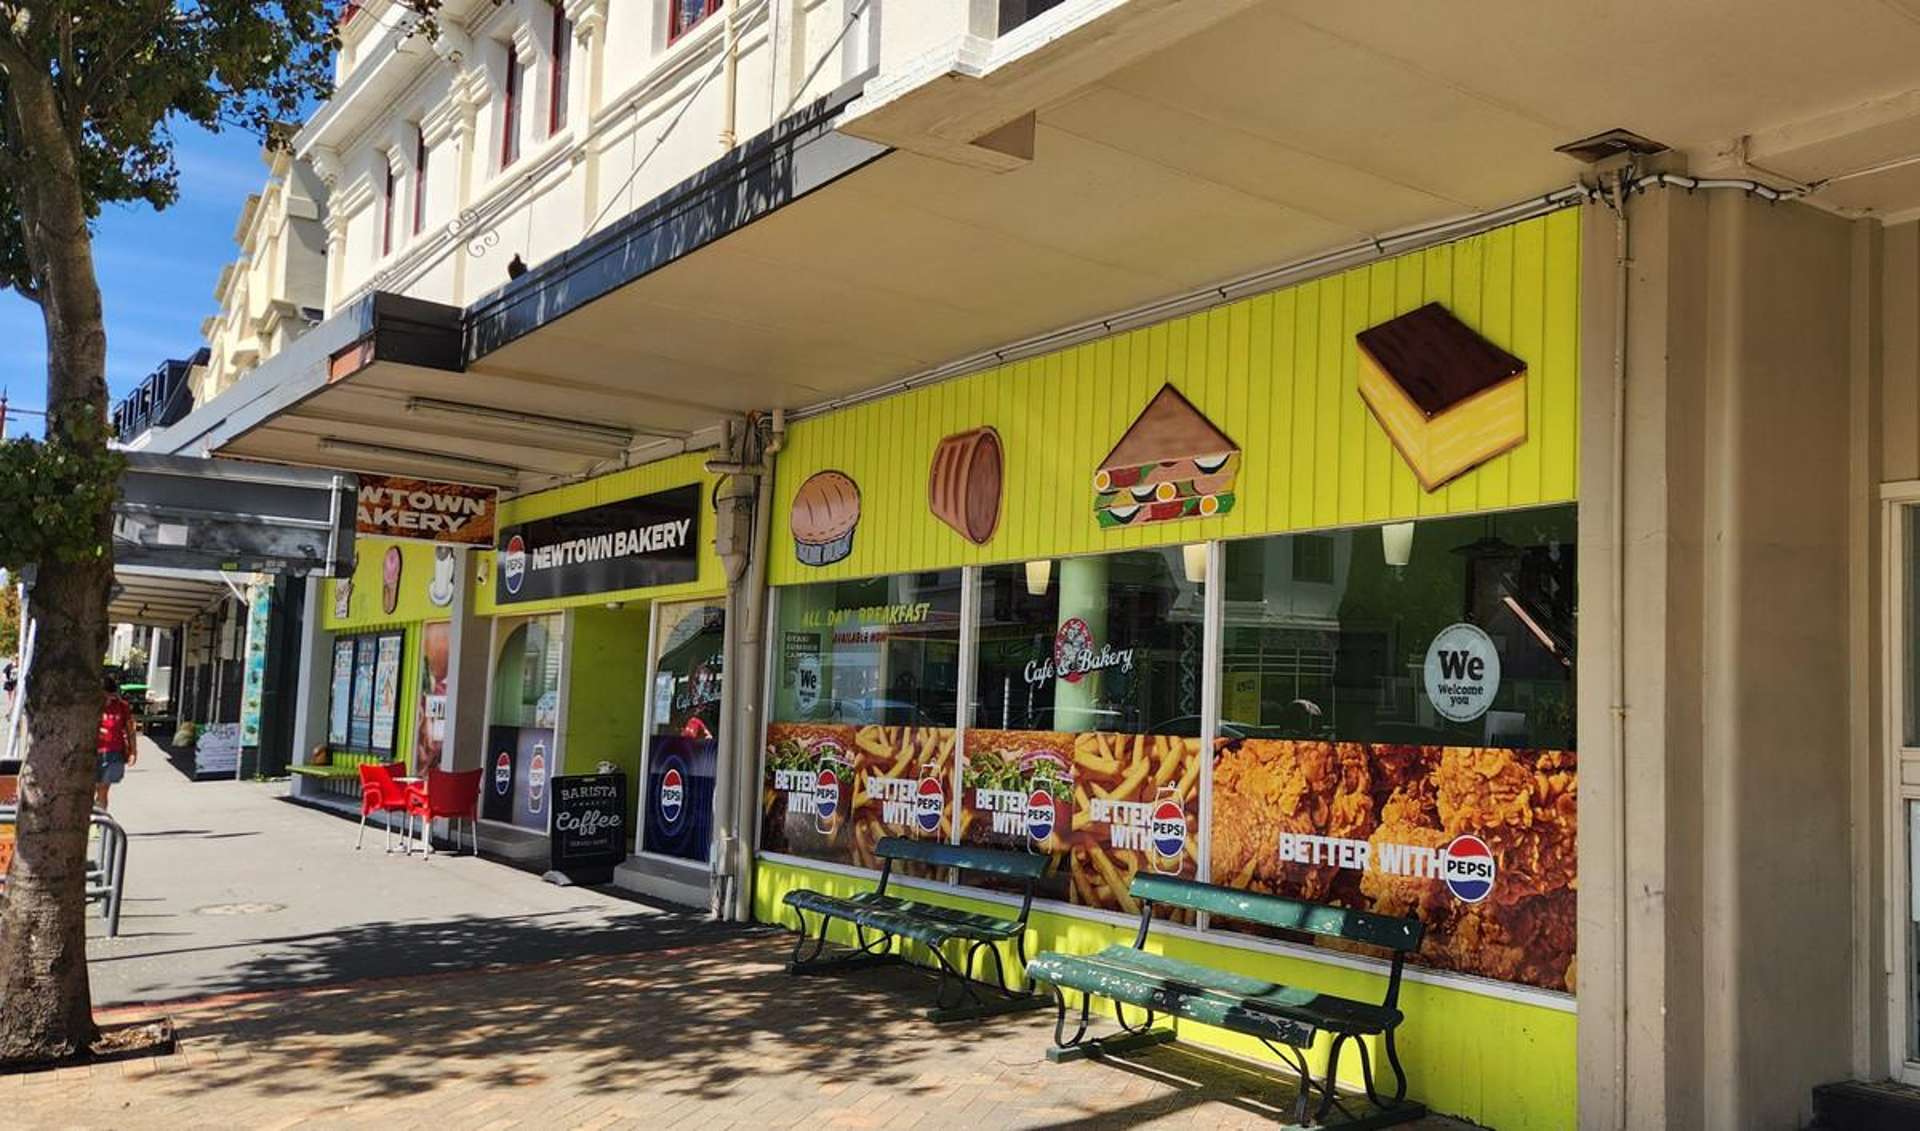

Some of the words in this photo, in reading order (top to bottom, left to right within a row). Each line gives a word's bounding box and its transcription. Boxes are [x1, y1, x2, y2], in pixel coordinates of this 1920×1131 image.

[358, 485, 486, 517] WTOWN
[357, 506, 468, 533] AKERY
[531, 532, 613, 571] NEWTOWN
[614, 518, 692, 558] BAKERY
[801, 609, 822, 629] ALL
[828, 607, 851, 626] DAY
[858, 602, 931, 625] BREAKFAST
[1076, 643, 1134, 674] Bakery
[1437, 650, 1485, 681] We
[800, 669, 817, 689] We
[1437, 684, 1484, 696] Welcome
[1449, 695, 1470, 707] you
[561, 786, 617, 801] BARISTA
[774, 769, 817, 793] BETTER
[816, 787, 838, 800] PEPSI
[866, 776, 918, 803] BETTER
[788, 791, 817, 815] WITH
[882, 800, 917, 827] WITH
[917, 797, 942, 810] PEPSI
[975, 788, 1028, 815] BETTER
[1028, 808, 1053, 822] PEPSI
[1090, 797, 1153, 827] BETTER
[555, 809, 622, 836] Coffee
[992, 811, 1027, 836] WITH
[1152, 822, 1185, 837] PEPSI
[1110, 824, 1152, 851] WITH
[1279, 831, 1371, 871] BETTER
[1379, 842, 1449, 881] WITH
[1447, 859, 1492, 878] PEPSI
